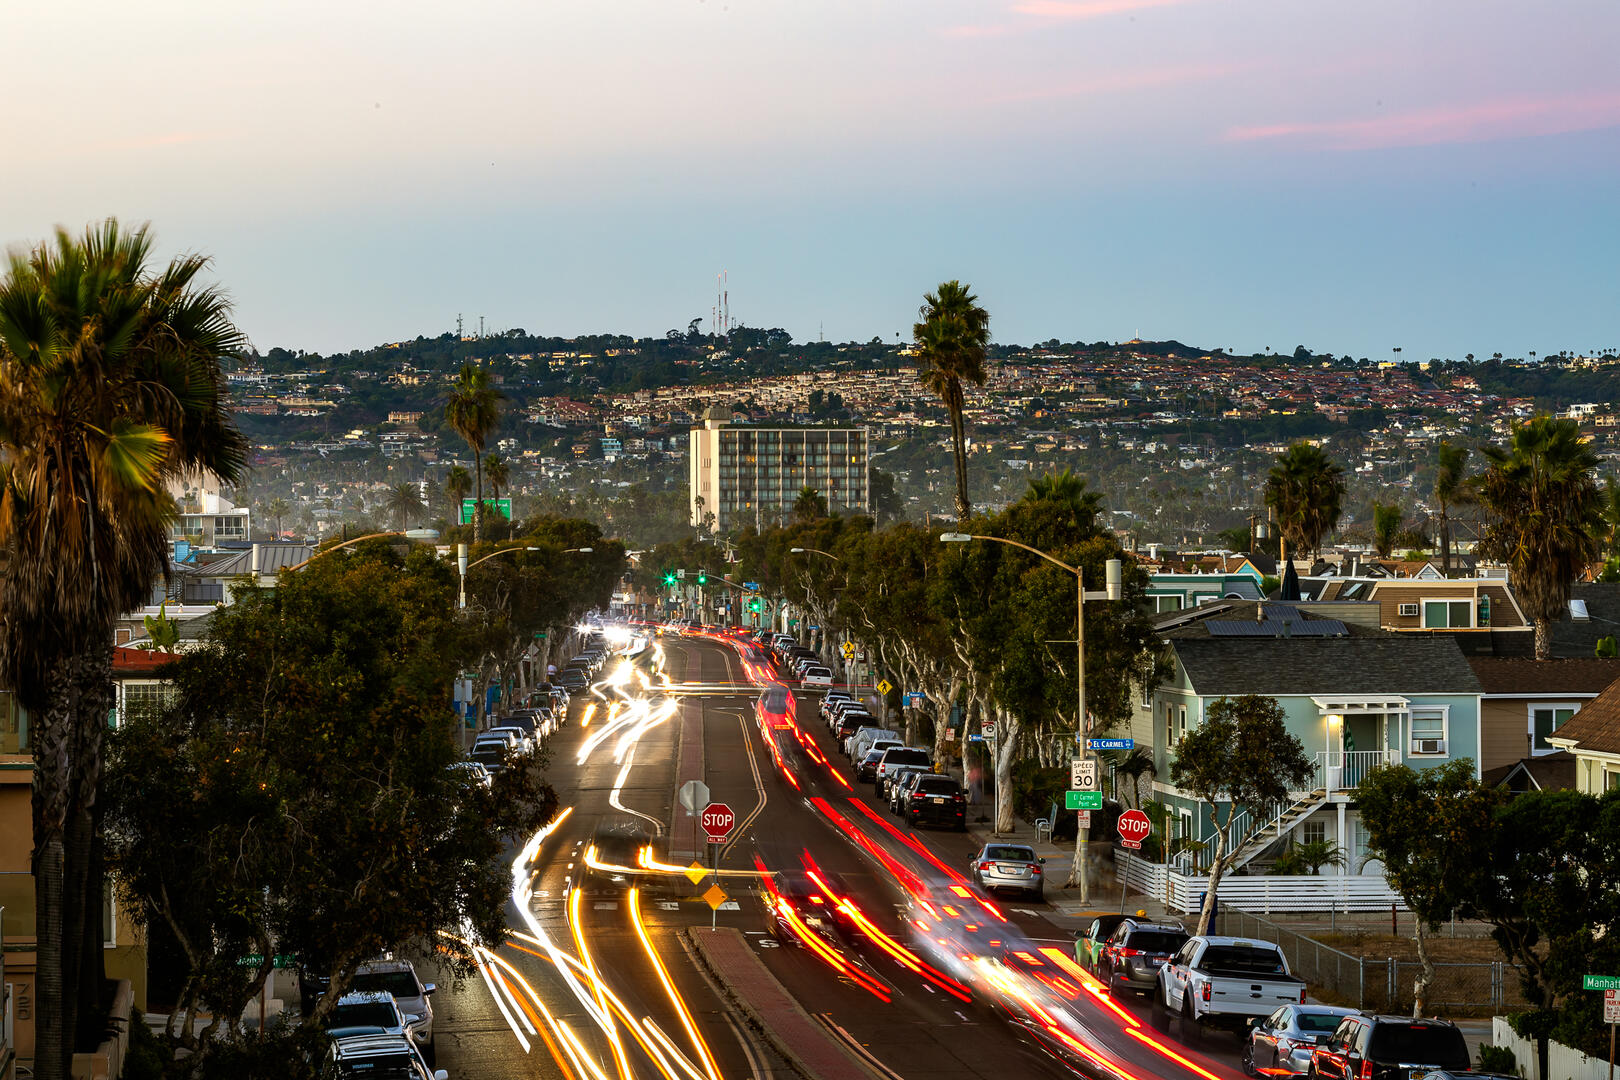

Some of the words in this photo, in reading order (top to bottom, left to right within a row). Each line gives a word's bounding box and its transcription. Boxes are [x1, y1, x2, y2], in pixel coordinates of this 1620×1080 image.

[1093, 740, 1100, 748] EL
[1101, 740, 1124, 748] CARMEL
[1074, 775, 1093, 787] 30
[703, 813, 732, 826] STOP
[1119, 818, 1148, 833] STOP
